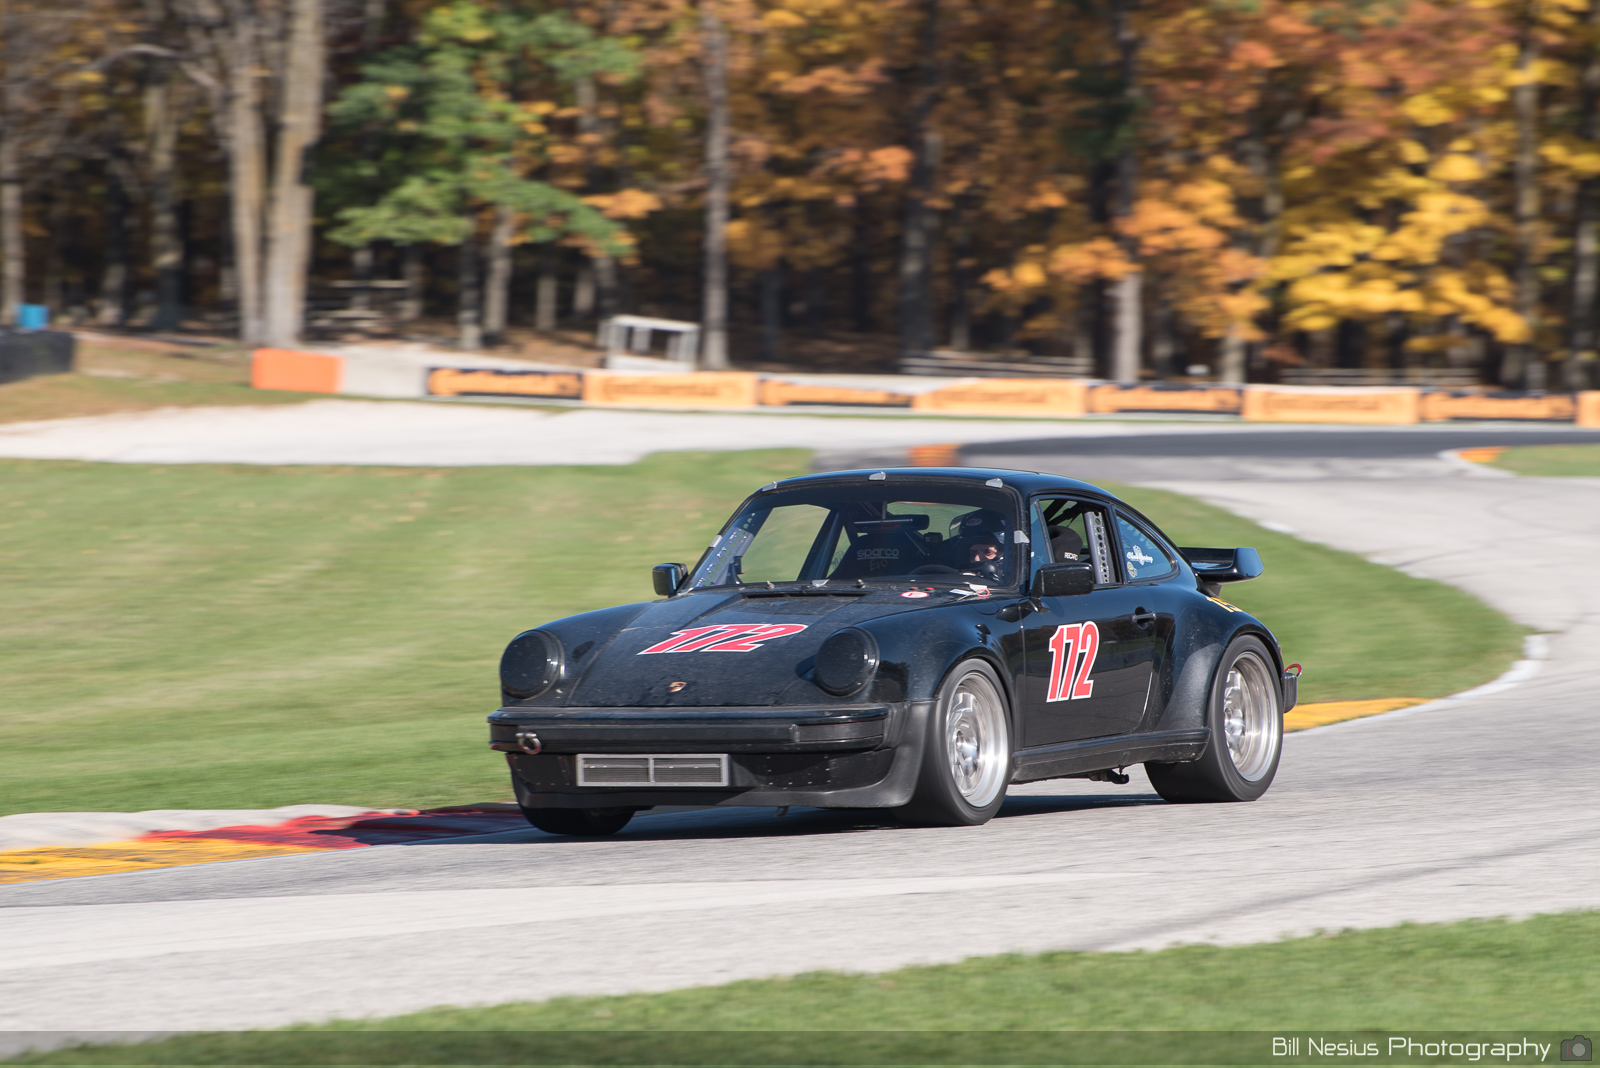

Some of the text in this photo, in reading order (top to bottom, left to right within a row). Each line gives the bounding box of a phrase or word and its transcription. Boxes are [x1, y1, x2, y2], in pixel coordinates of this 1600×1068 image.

[856, 548, 900, 560] sparco
[636, 623, 809, 656] 172
[1046, 621, 1100, 703] 172
